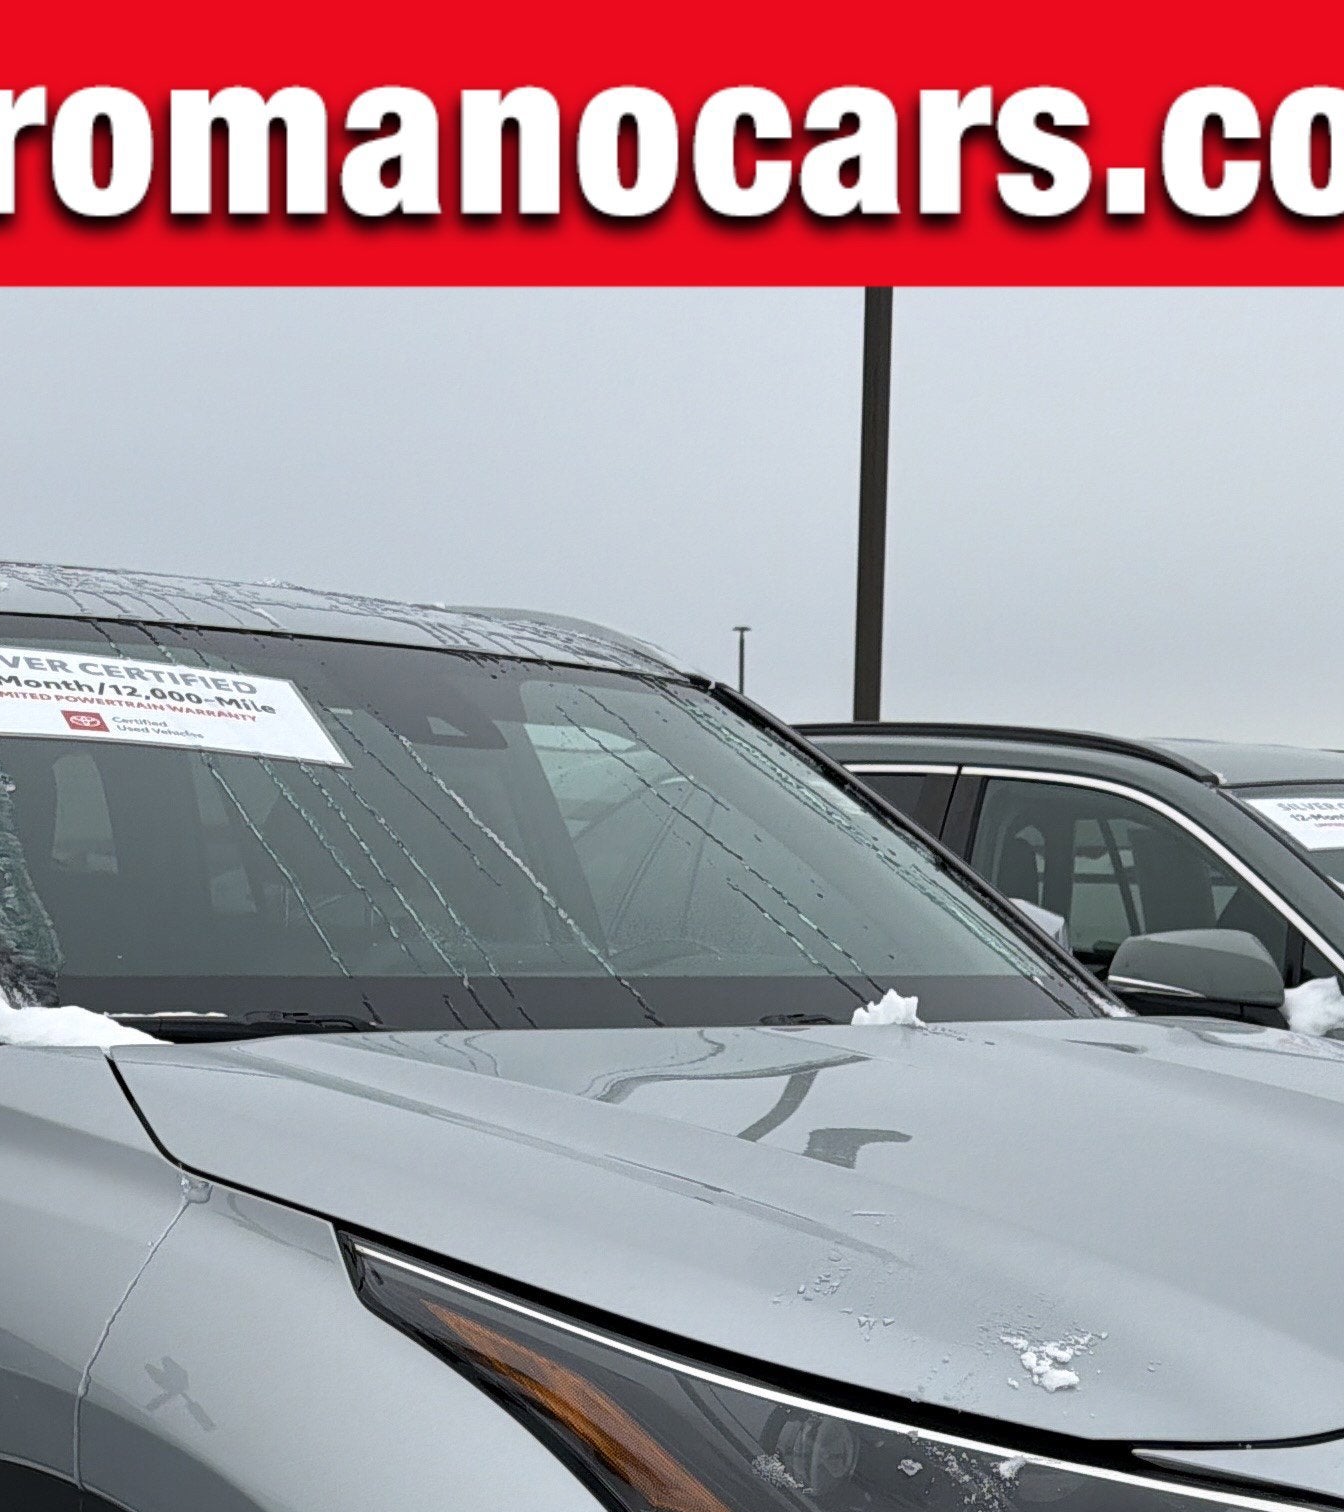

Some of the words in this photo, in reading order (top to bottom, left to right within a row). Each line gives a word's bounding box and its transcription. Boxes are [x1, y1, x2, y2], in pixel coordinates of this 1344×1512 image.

[79, 662, 257, 695] CERTIFIED
[54, 694, 165, 712] POWERTRAIN
[166, 704, 257, 722] WARRANTY
[112, 716, 168, 728] Certified
[117, 725, 150, 733] Used
[1276, 802, 1337, 812] SILVER
